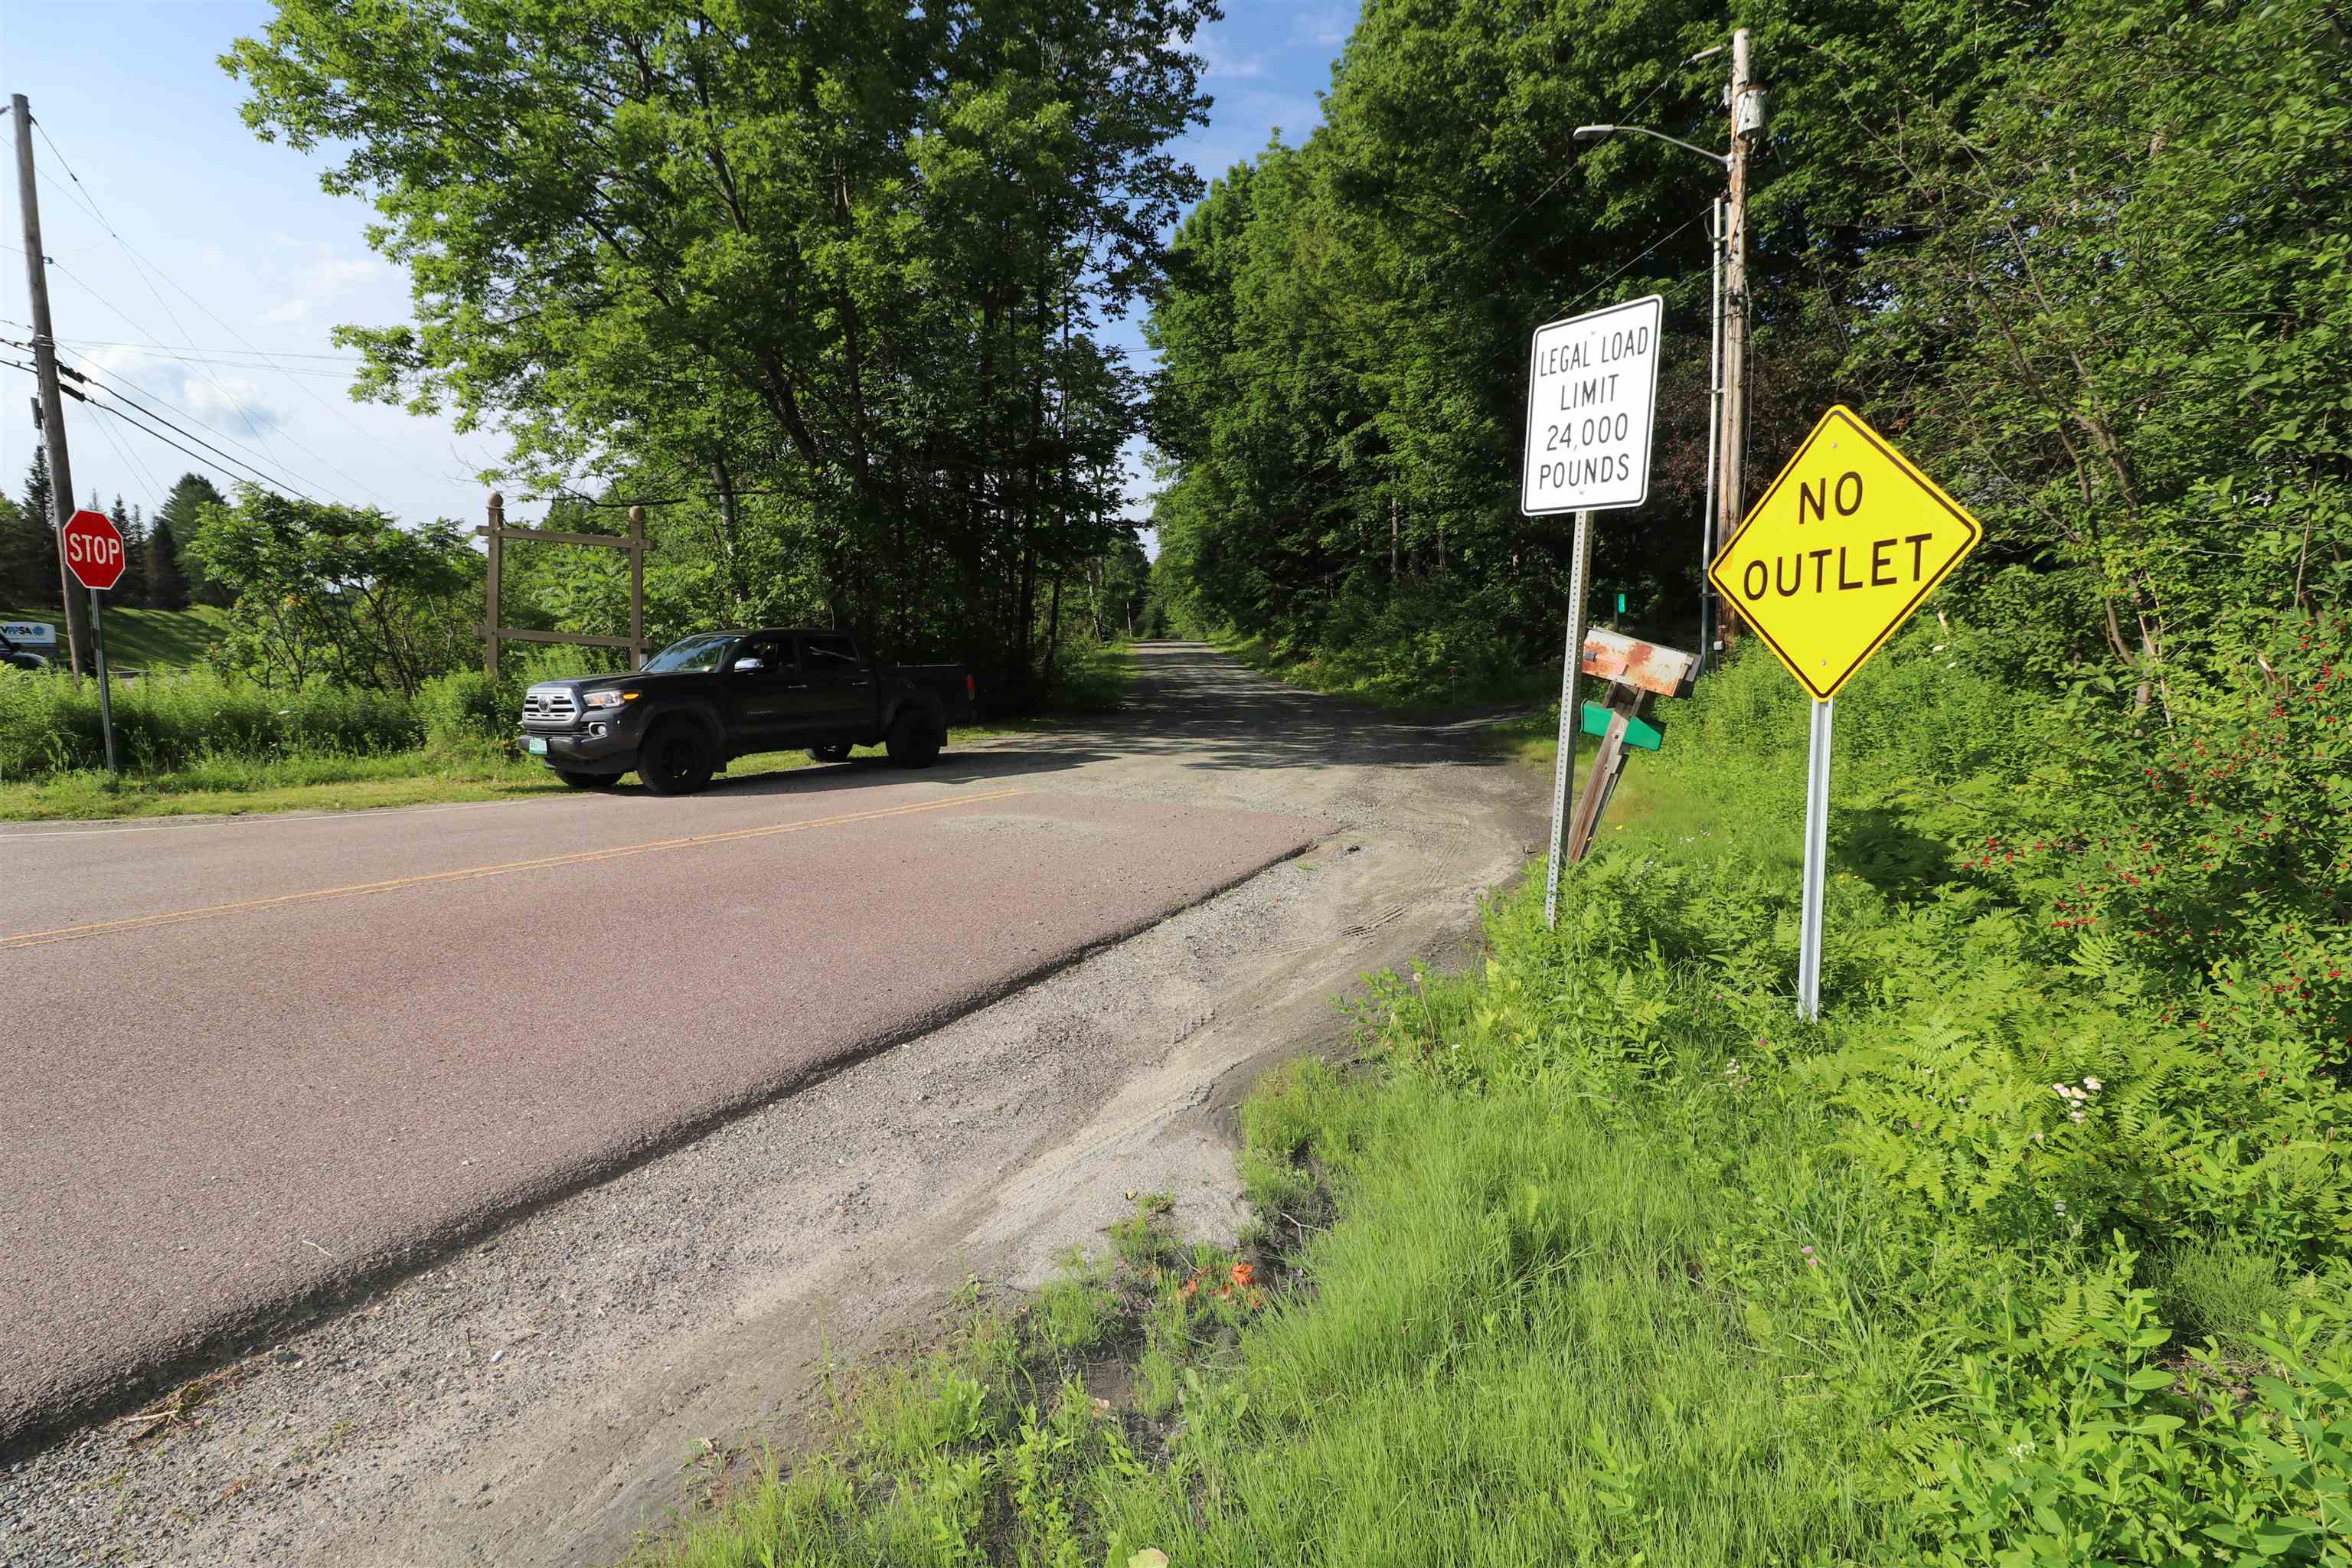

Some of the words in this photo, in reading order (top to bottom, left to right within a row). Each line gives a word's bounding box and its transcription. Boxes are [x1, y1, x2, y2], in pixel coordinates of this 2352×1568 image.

[1540, 340, 1591, 377] LEGAL
[1601, 325, 1648, 363] LOAD
[1560, 374, 1619, 411] LIMIT
[1546, 412, 1628, 452] 24,000
[1539, 452, 1629, 491] POUNDS
[1798, 471, 1864, 525] NO
[69, 532, 120, 565] STOP
[1743, 532, 1933, 602] OUTLET
